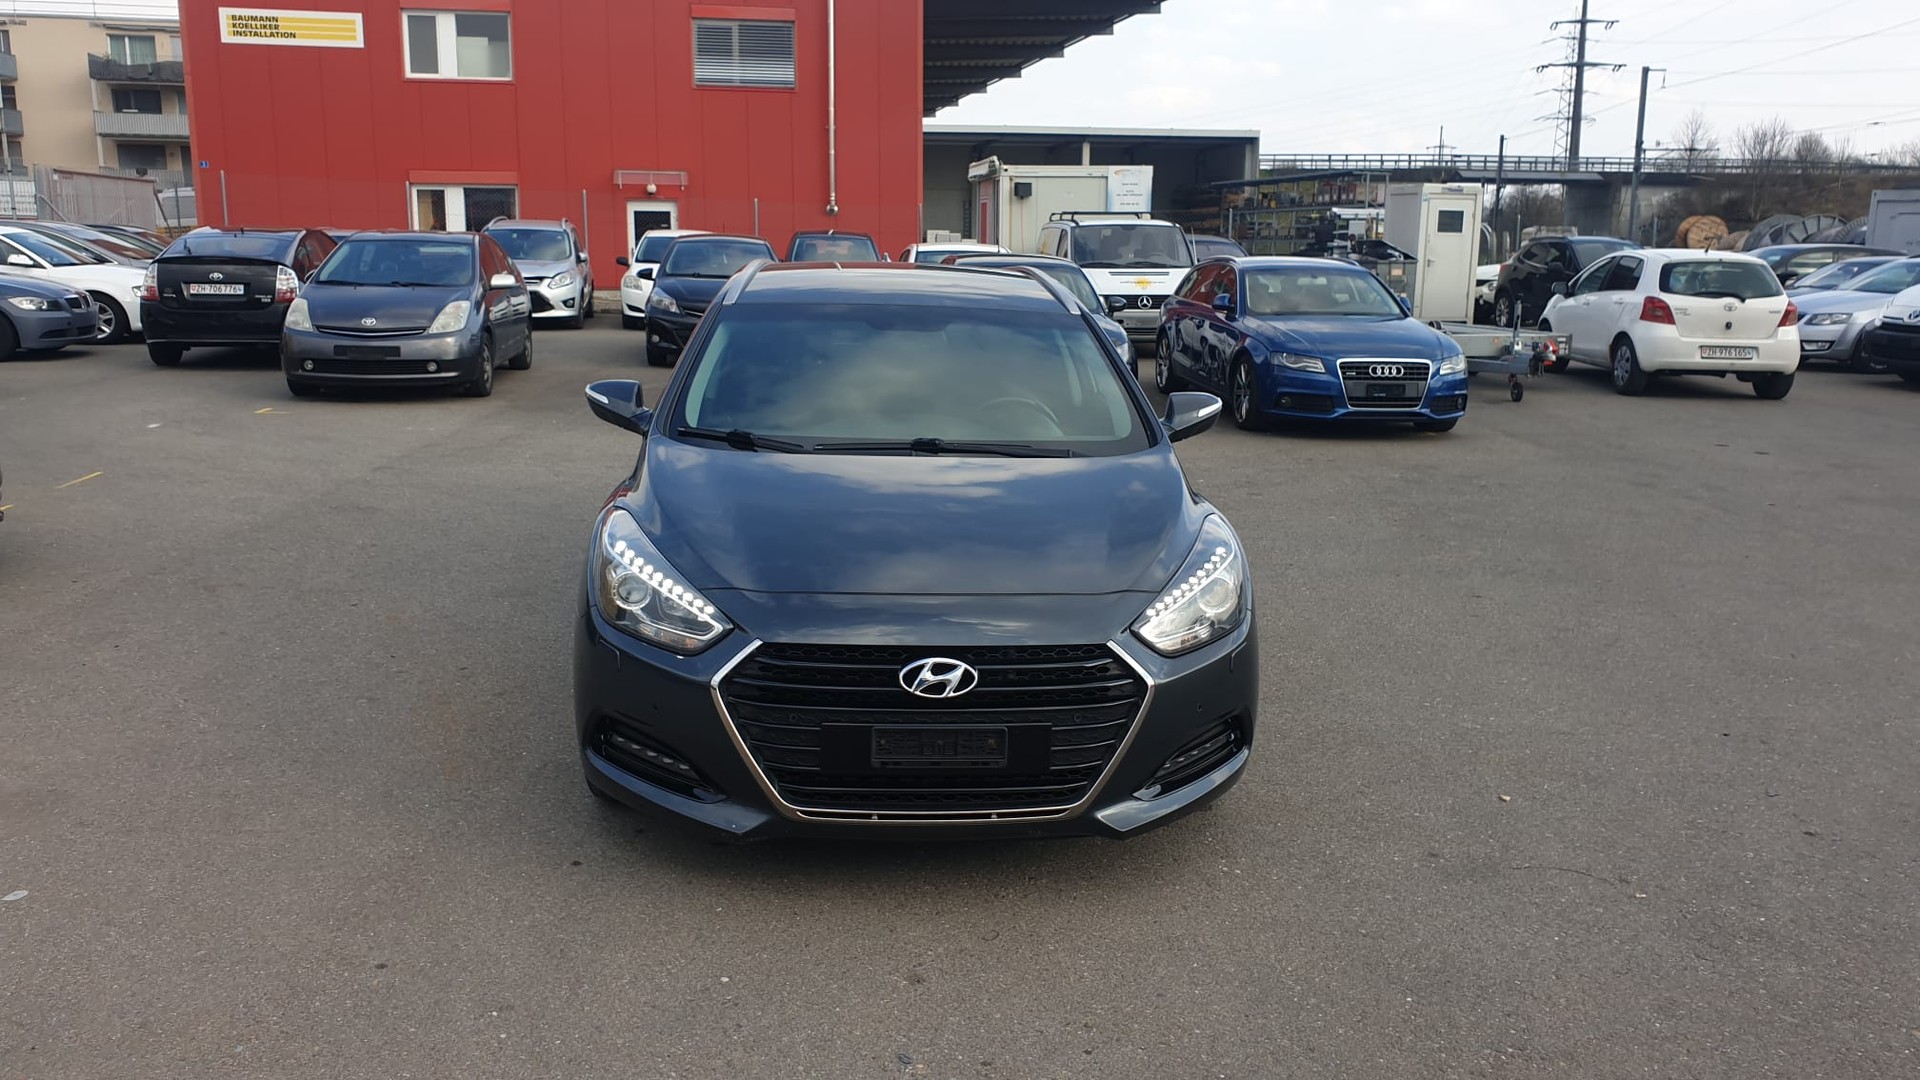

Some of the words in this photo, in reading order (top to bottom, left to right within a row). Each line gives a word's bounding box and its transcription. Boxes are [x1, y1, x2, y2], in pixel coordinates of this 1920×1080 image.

[231, 14, 279, 23] BAUMANN
[232, 22, 280, 31] KOELLIKER
[232, 30, 297, 39] INSTALLATION
